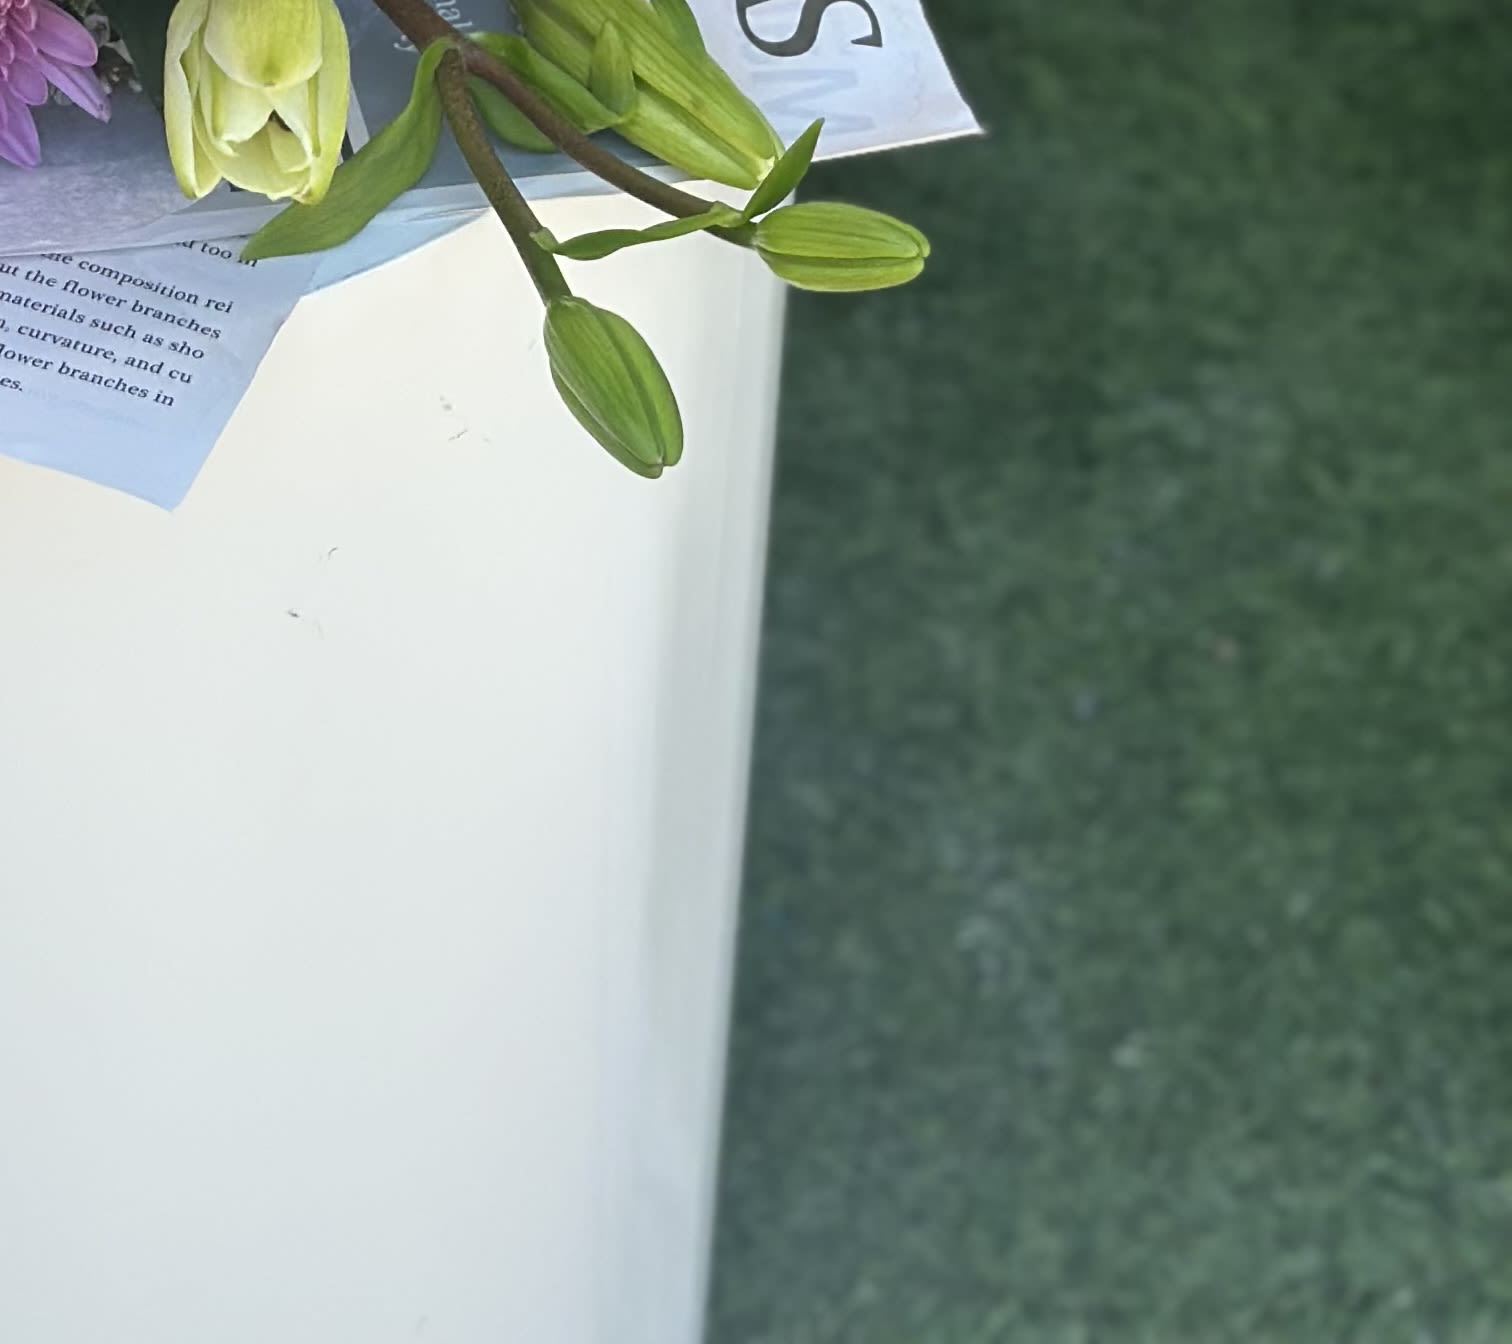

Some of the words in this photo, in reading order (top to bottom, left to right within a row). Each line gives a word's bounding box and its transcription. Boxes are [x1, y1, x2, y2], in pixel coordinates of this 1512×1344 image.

[199, 239, 232, 261] too
[24, 267, 58, 290] the
[63, 279, 128, 309] flower
[131, 298, 222, 340] branches
[77, 258, 200, 306] composition
[16, 323, 118, 364] curvature,
[124, 354, 166, 376] and
[168, 367, 193, 386] cu
[89, 315, 137, 341] such
[142, 333, 164, 348] as
[169, 335, 206, 361] sho
[58, 359, 149, 399] branches
[153, 388, 176, 408] in
